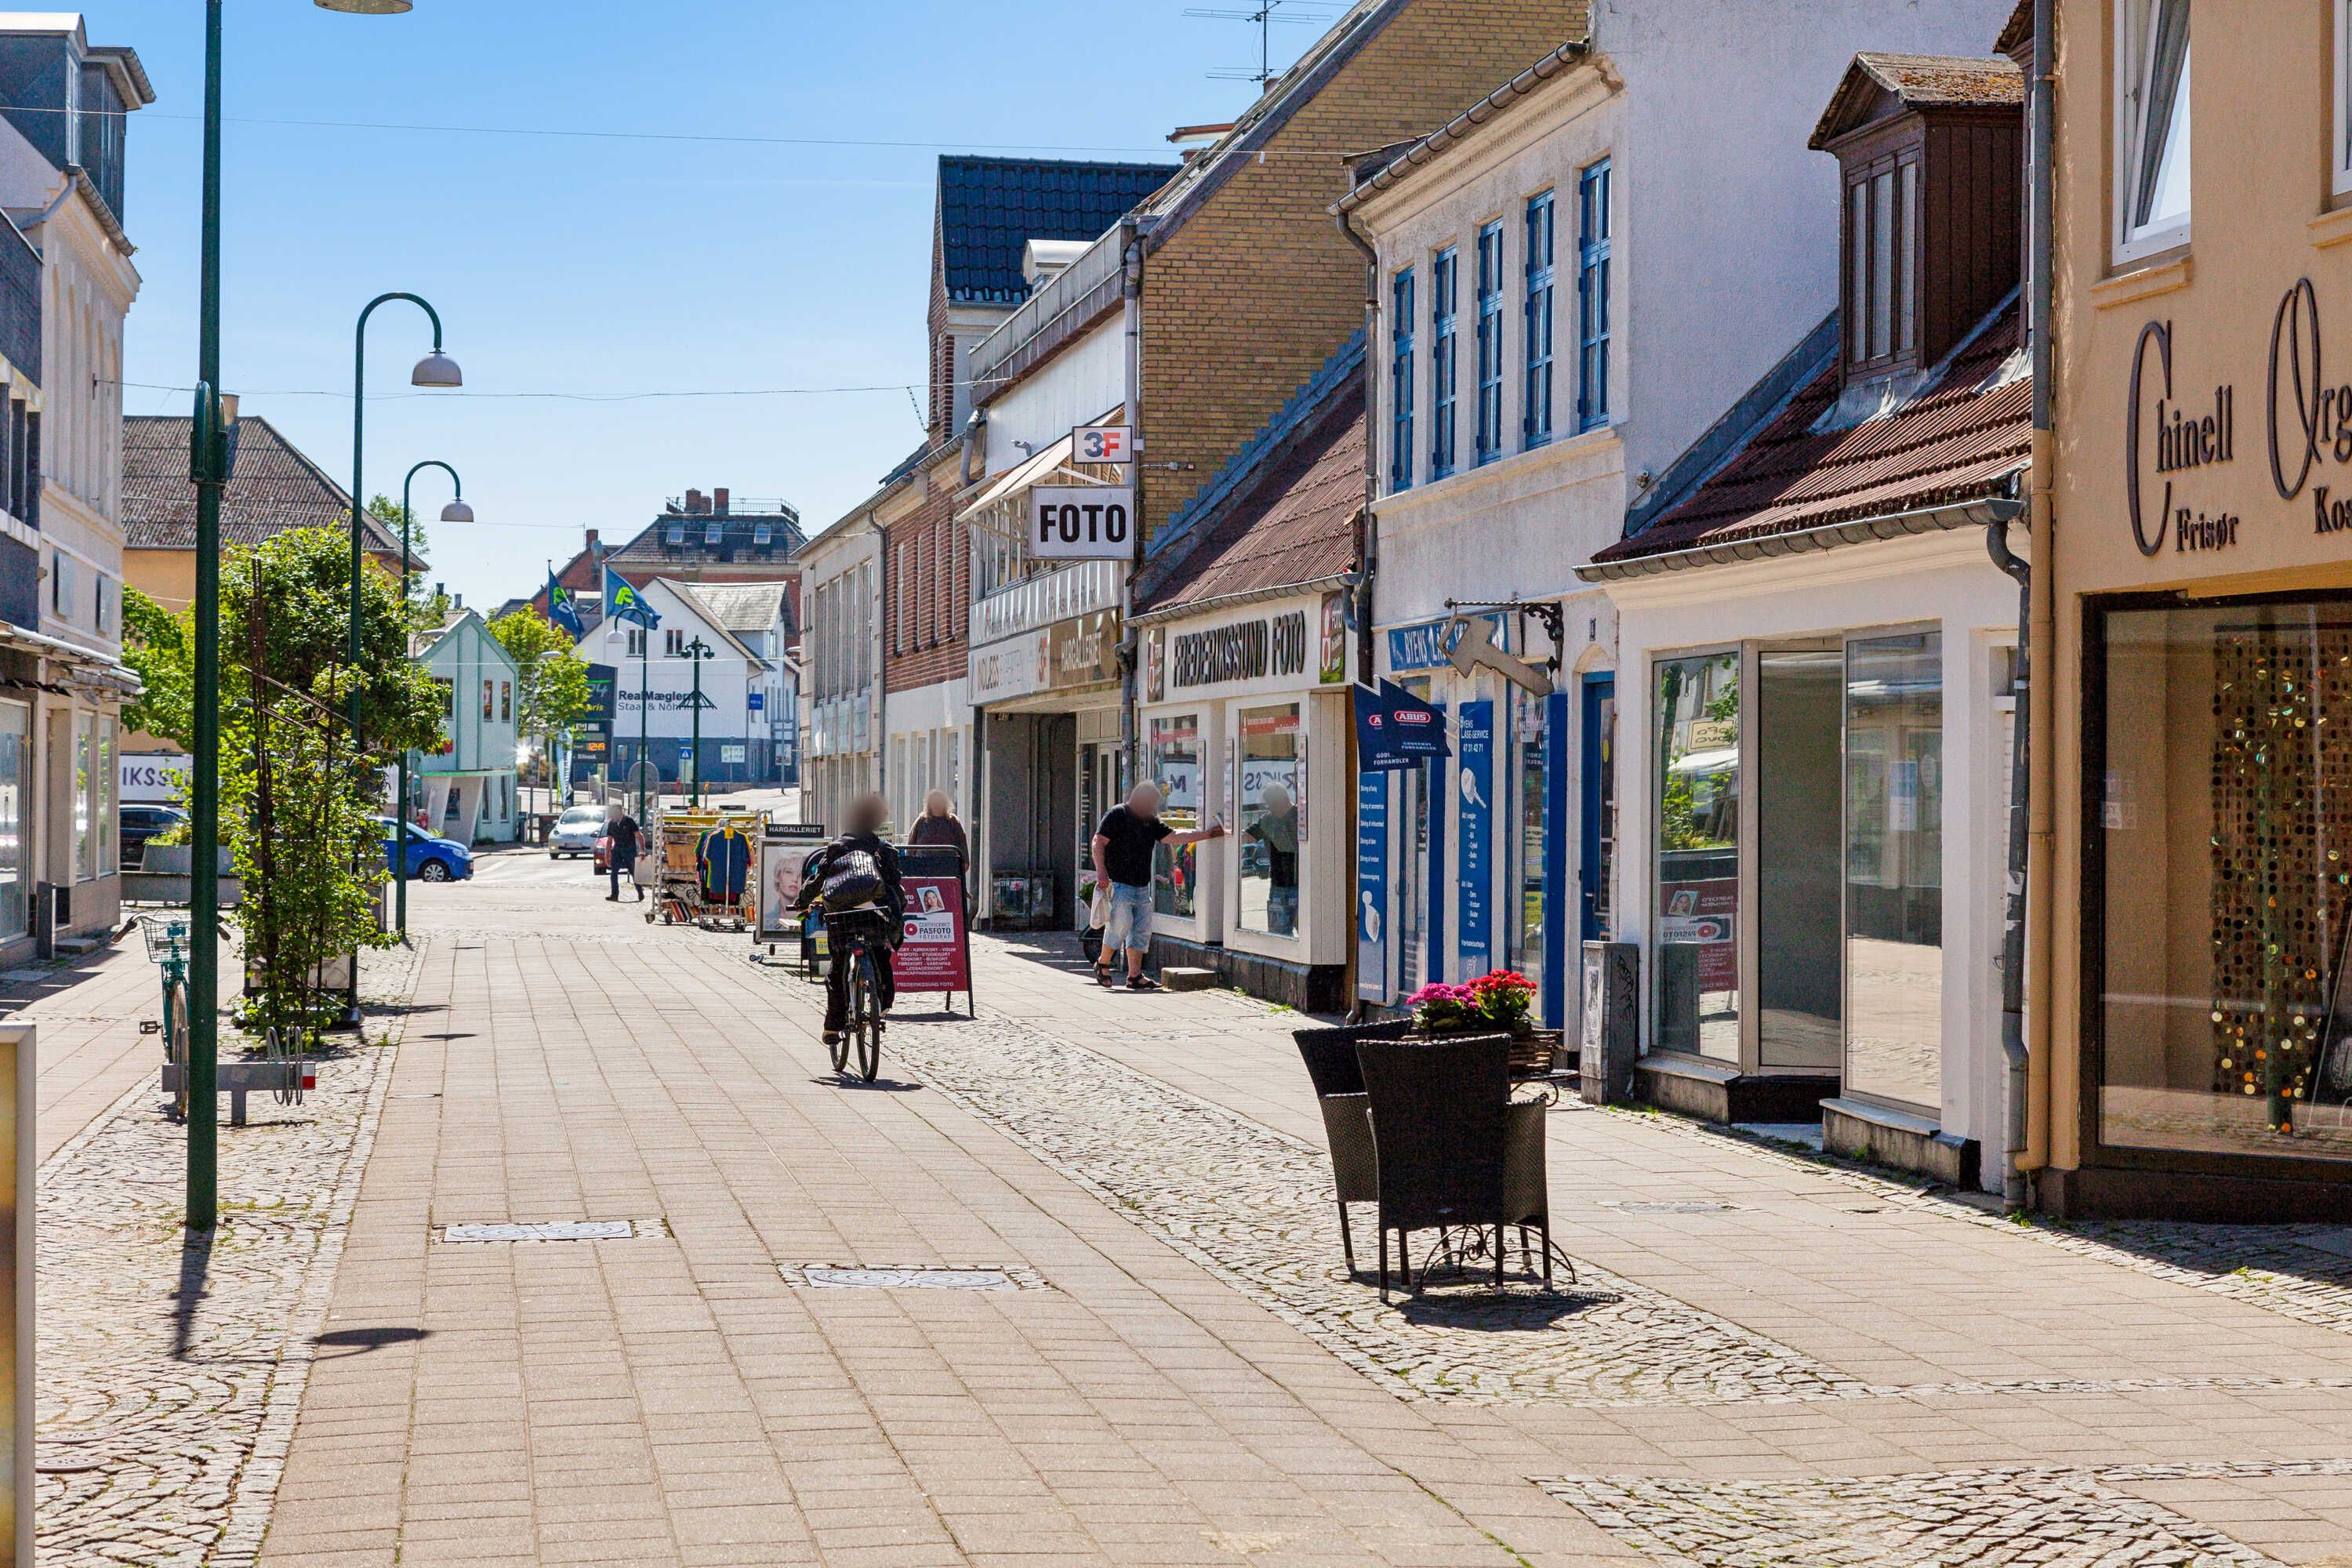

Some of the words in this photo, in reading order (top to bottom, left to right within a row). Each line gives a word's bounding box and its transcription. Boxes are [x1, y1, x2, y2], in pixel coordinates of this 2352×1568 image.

[1083, 431, 1121, 458] 3F
[2126, 320, 2234, 557] Chinell
[1040, 503, 1127, 543] FOTO
[2175, 507, 2239, 553] Frisør
[1061, 632, 1102, 672] HARGALLERIET
[1173, 619, 1269, 688] FREDERIKSSUND
[1272, 610, 1306, 676] FOTO
[1404, 628, 1427, 664] BYENS
[1399, 713, 1426, 721] ABUS
